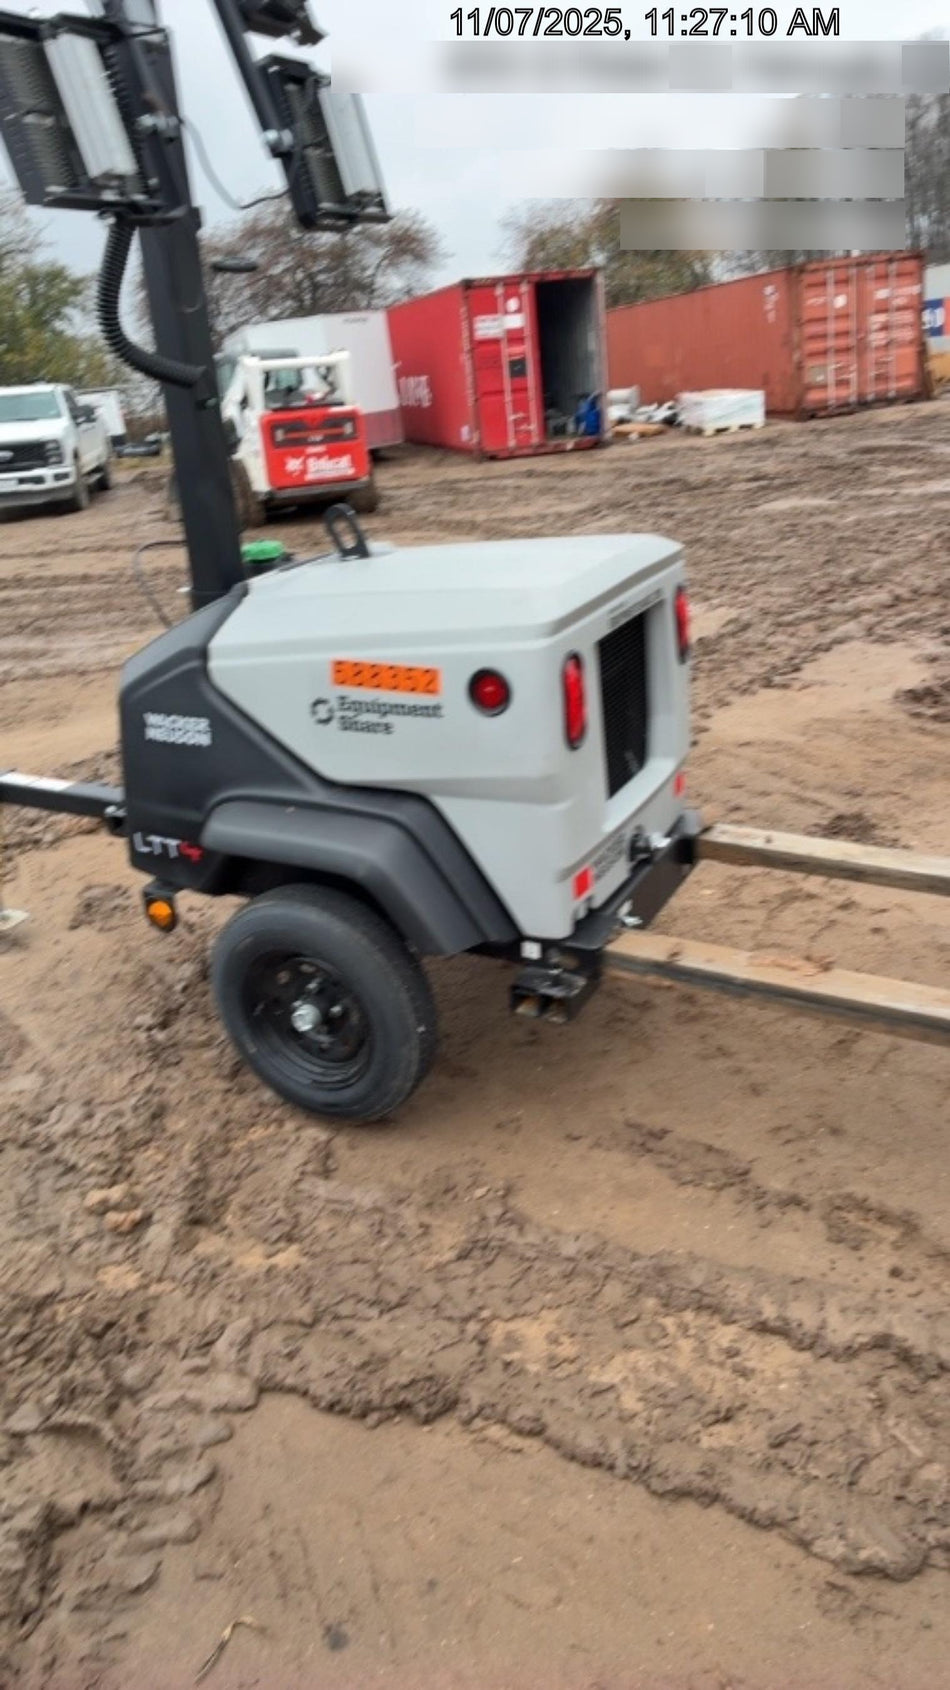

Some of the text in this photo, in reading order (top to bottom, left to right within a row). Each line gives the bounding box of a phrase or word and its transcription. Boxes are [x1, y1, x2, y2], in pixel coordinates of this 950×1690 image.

[336, 695, 443, 719] Equipment
[143, 711, 210, 732] WACKER
[337, 714, 394, 735] Share
[144, 727, 212, 747] NEUSON
[133, 832, 203, 866] LTT4
